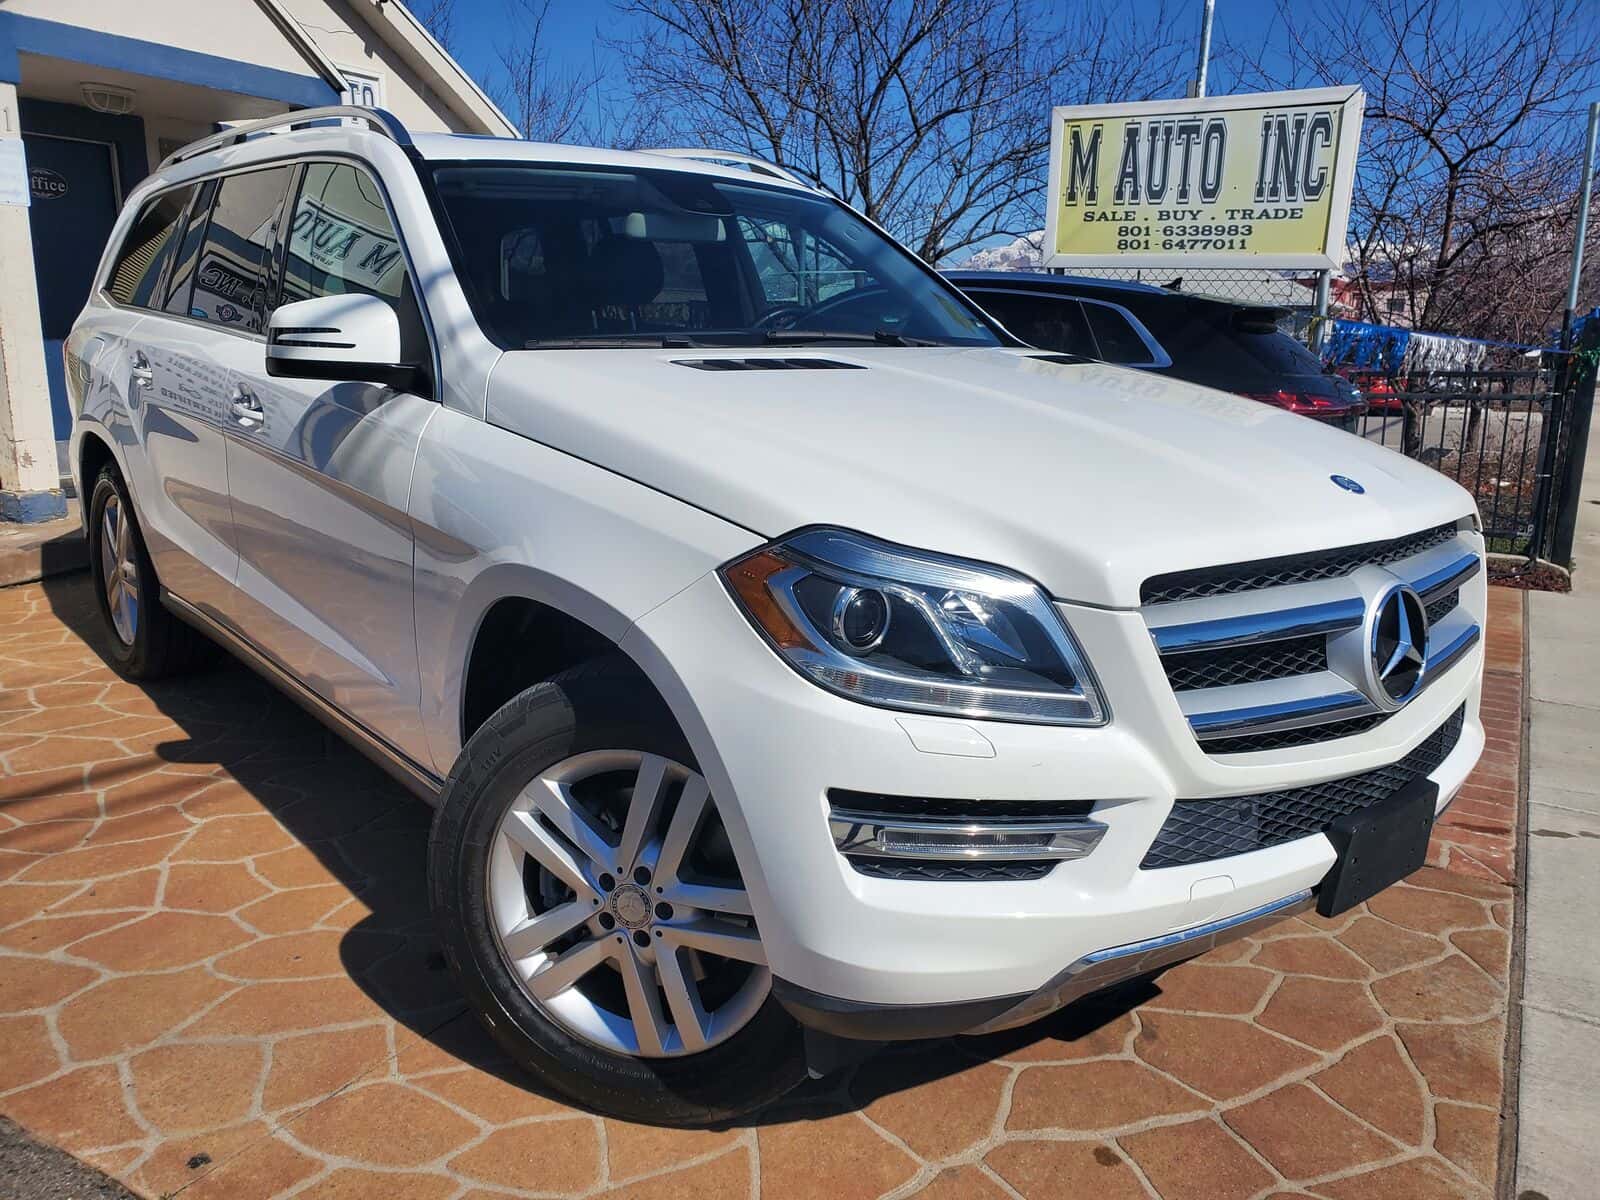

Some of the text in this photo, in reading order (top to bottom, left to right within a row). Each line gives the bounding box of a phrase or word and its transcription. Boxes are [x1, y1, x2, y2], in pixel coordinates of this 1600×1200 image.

[1065, 111, 1334, 206] M AUTO INC
[31, 175, 65, 192] ffice
[1083, 207, 1304, 222] SALE BUY TRADE
[1118, 224, 1253, 237] 801-6338983
[1117, 238, 1247, 251] 801-6477011
